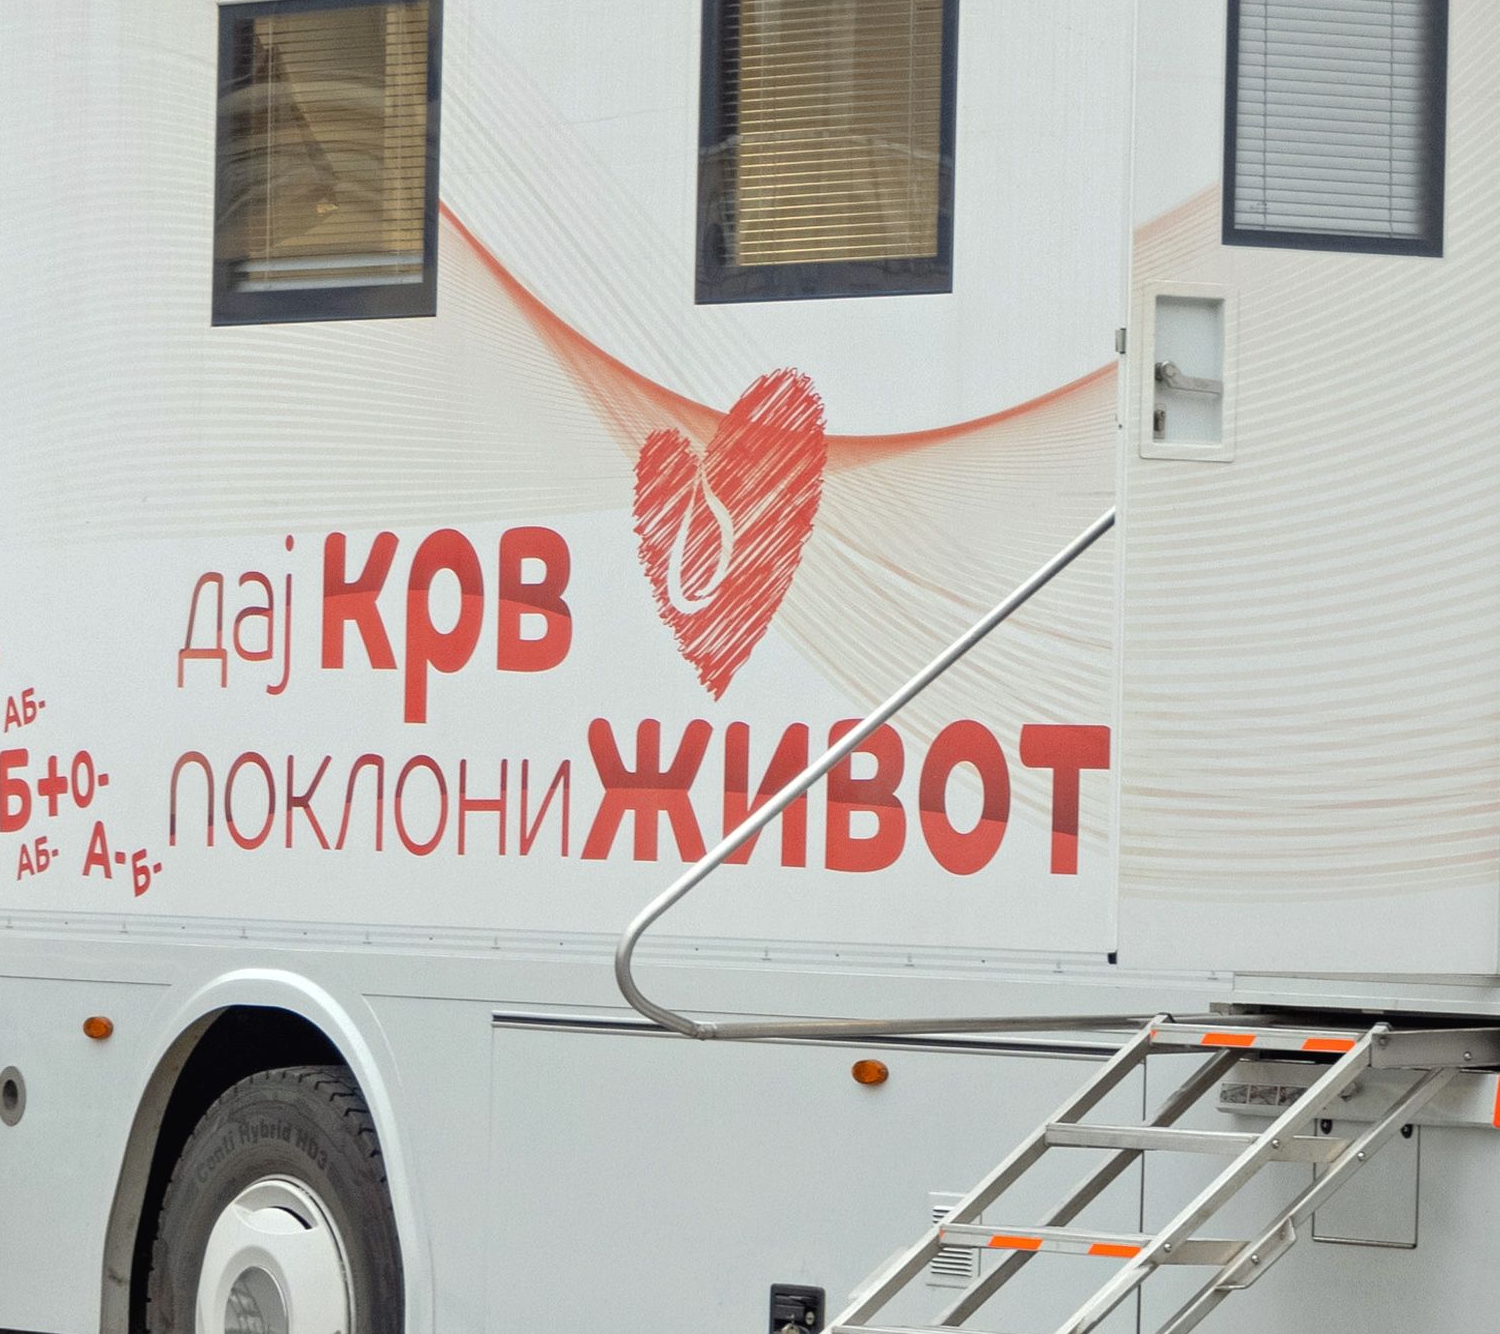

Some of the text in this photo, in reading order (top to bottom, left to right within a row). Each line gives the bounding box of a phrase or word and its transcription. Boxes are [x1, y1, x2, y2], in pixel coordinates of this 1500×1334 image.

[177, 527, 574, 725] дај крв
[169, 751, 572, 858] поклони
